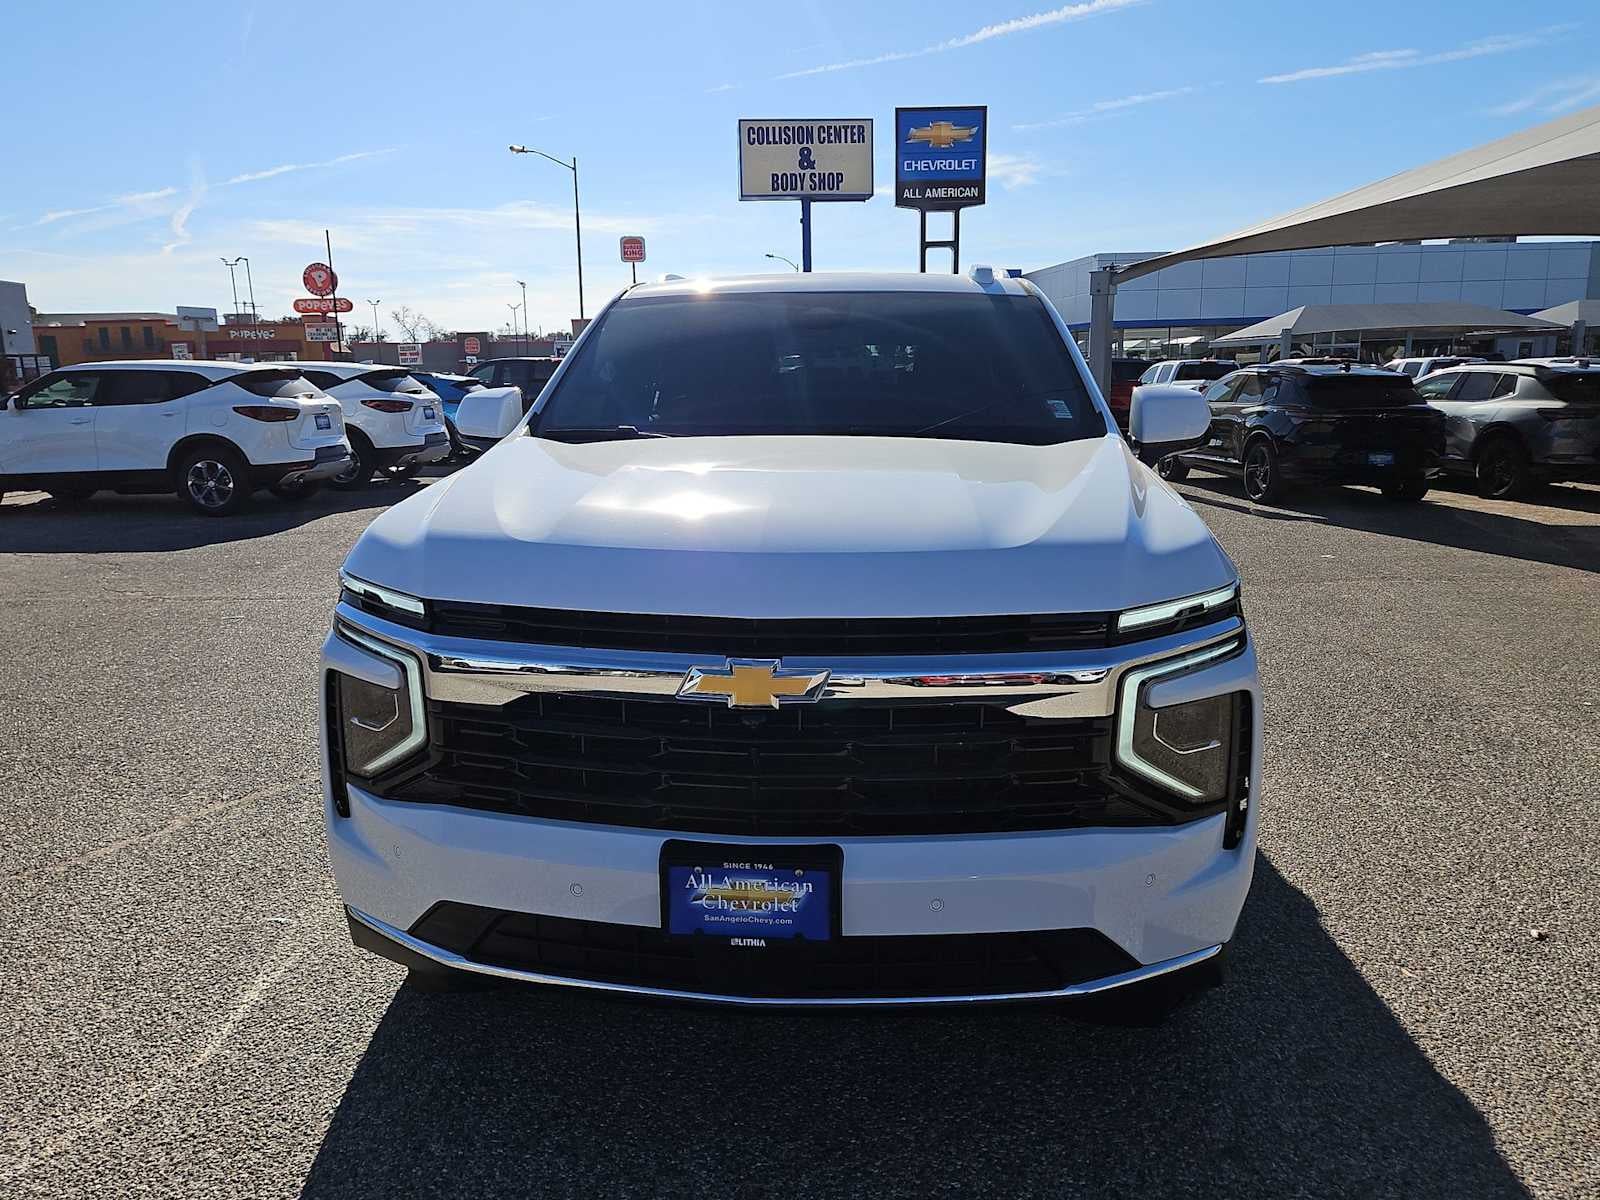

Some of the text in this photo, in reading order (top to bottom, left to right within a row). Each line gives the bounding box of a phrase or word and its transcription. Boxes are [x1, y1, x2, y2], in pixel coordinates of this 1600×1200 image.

[747, 124, 866, 146] COLLISION CENTER
[798, 146, 816, 170] &
[903, 158, 977, 171] CHEVROLET
[771, 172, 844, 192] BODY SHOP
[903, 186, 979, 198] ALL AMERICAN
[723, 862, 751, 870] SINCE
[685, 873, 813, 893] All American
[702, 893, 799, 913] Chevrolet
[704, 914, 793, 925] SanAngeloChevy.com
[738, 938, 766, 947] LITHIA
